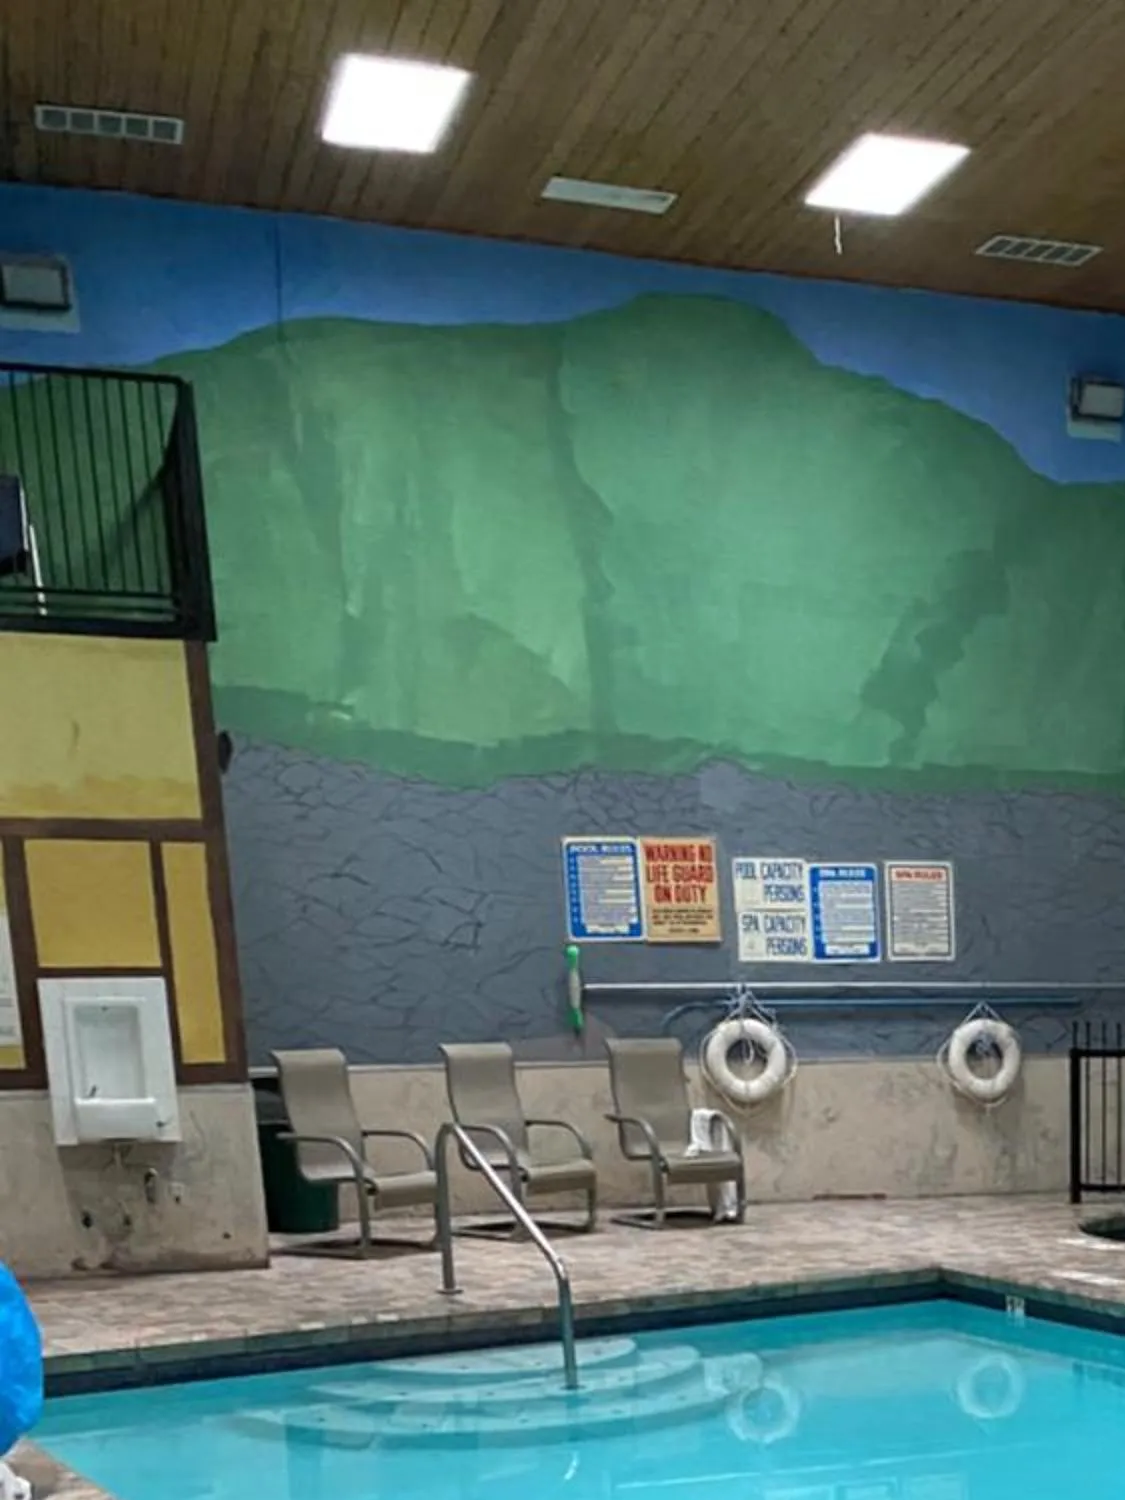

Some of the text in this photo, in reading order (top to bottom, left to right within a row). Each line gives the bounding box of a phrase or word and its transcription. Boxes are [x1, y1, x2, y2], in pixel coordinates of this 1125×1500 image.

[645, 844, 713, 862] WARNING NO
[646, 864, 714, 883] LIFE GUARD
[735, 862, 804, 881] POOL CAPACITY
[654, 885, 707, 903] ON DUTY
[764, 884, 805, 902] PERSONS
[742, 913, 806, 933] SPA CAPACITY
[766, 937, 808, 956] PERSONS
